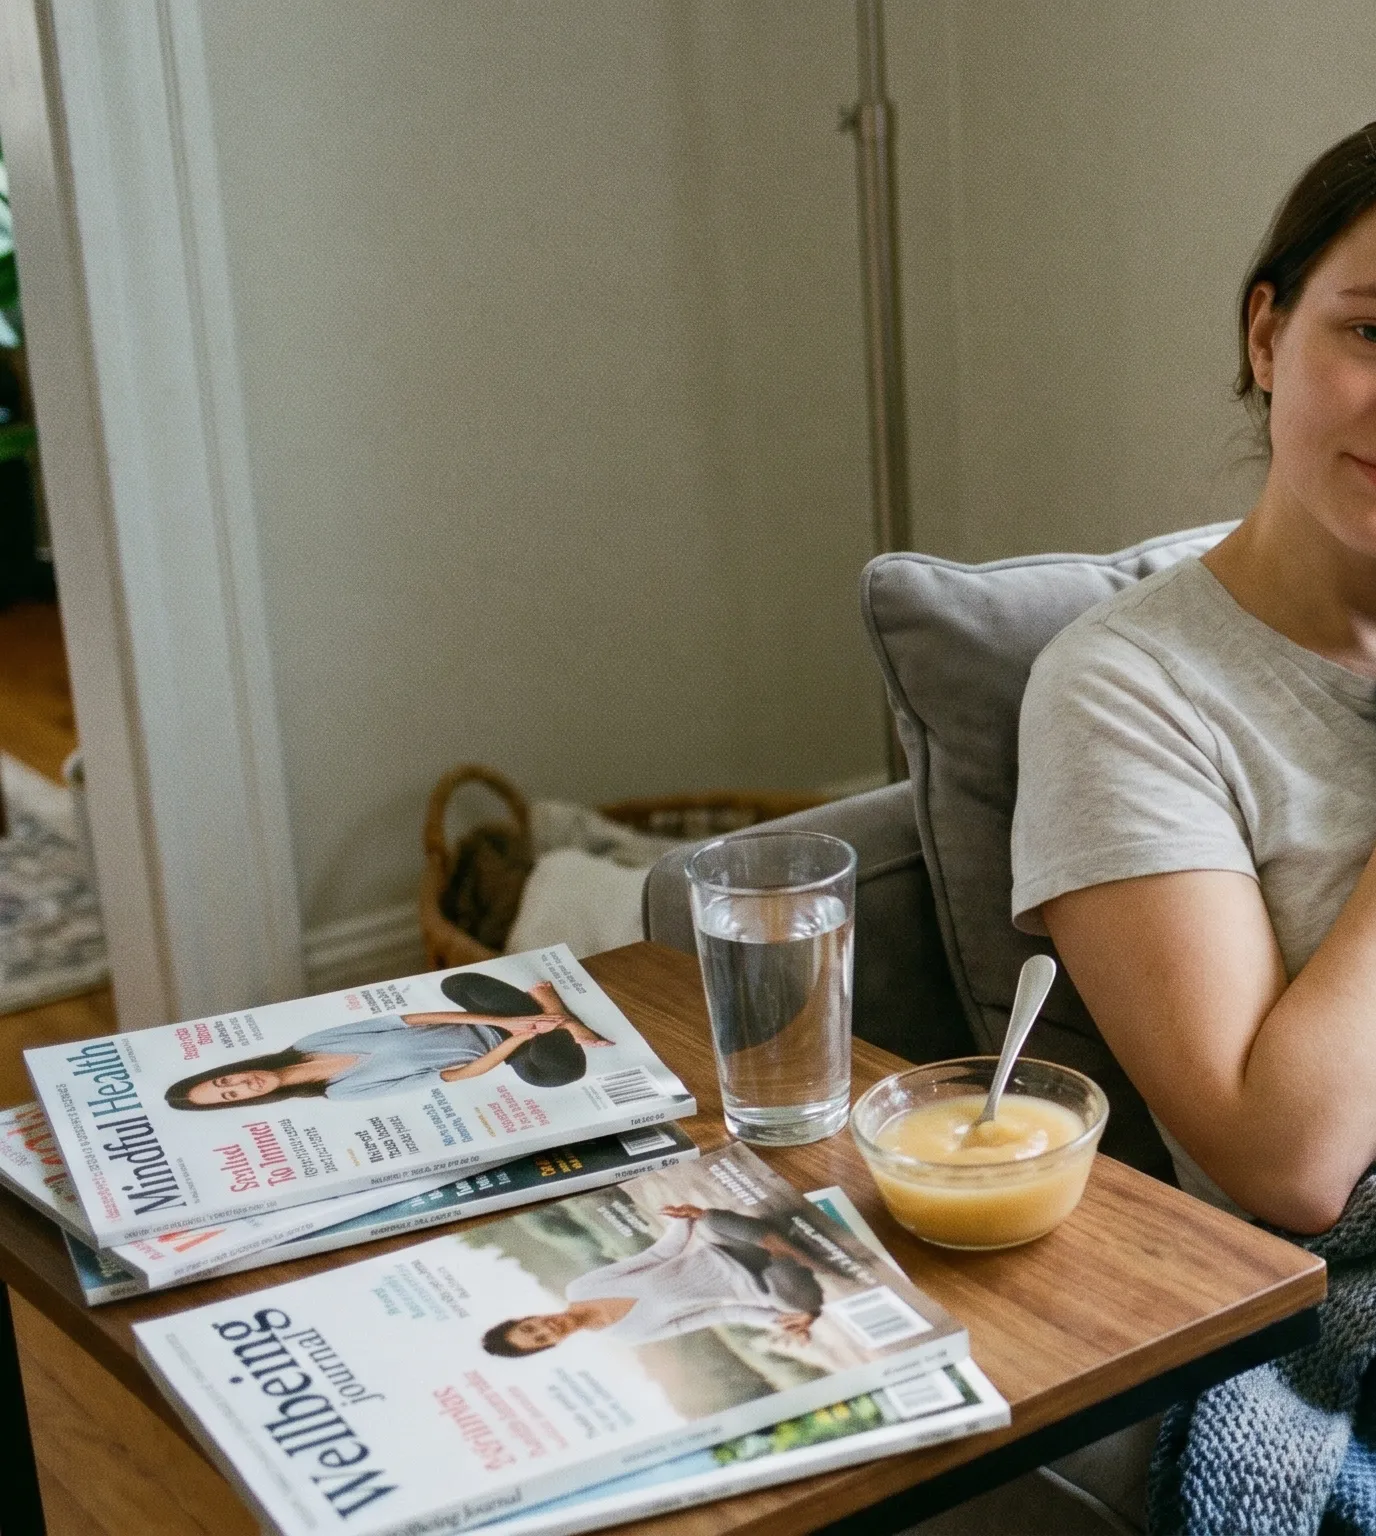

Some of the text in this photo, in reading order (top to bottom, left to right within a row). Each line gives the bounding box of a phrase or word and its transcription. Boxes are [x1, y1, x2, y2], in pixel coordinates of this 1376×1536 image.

[66, 1041, 143, 1118] Health
[96, 1114, 187, 1216] Mindful
[282, 1327, 386, 1407] journal
[211, 1308, 400, 1519] Wellbeing
